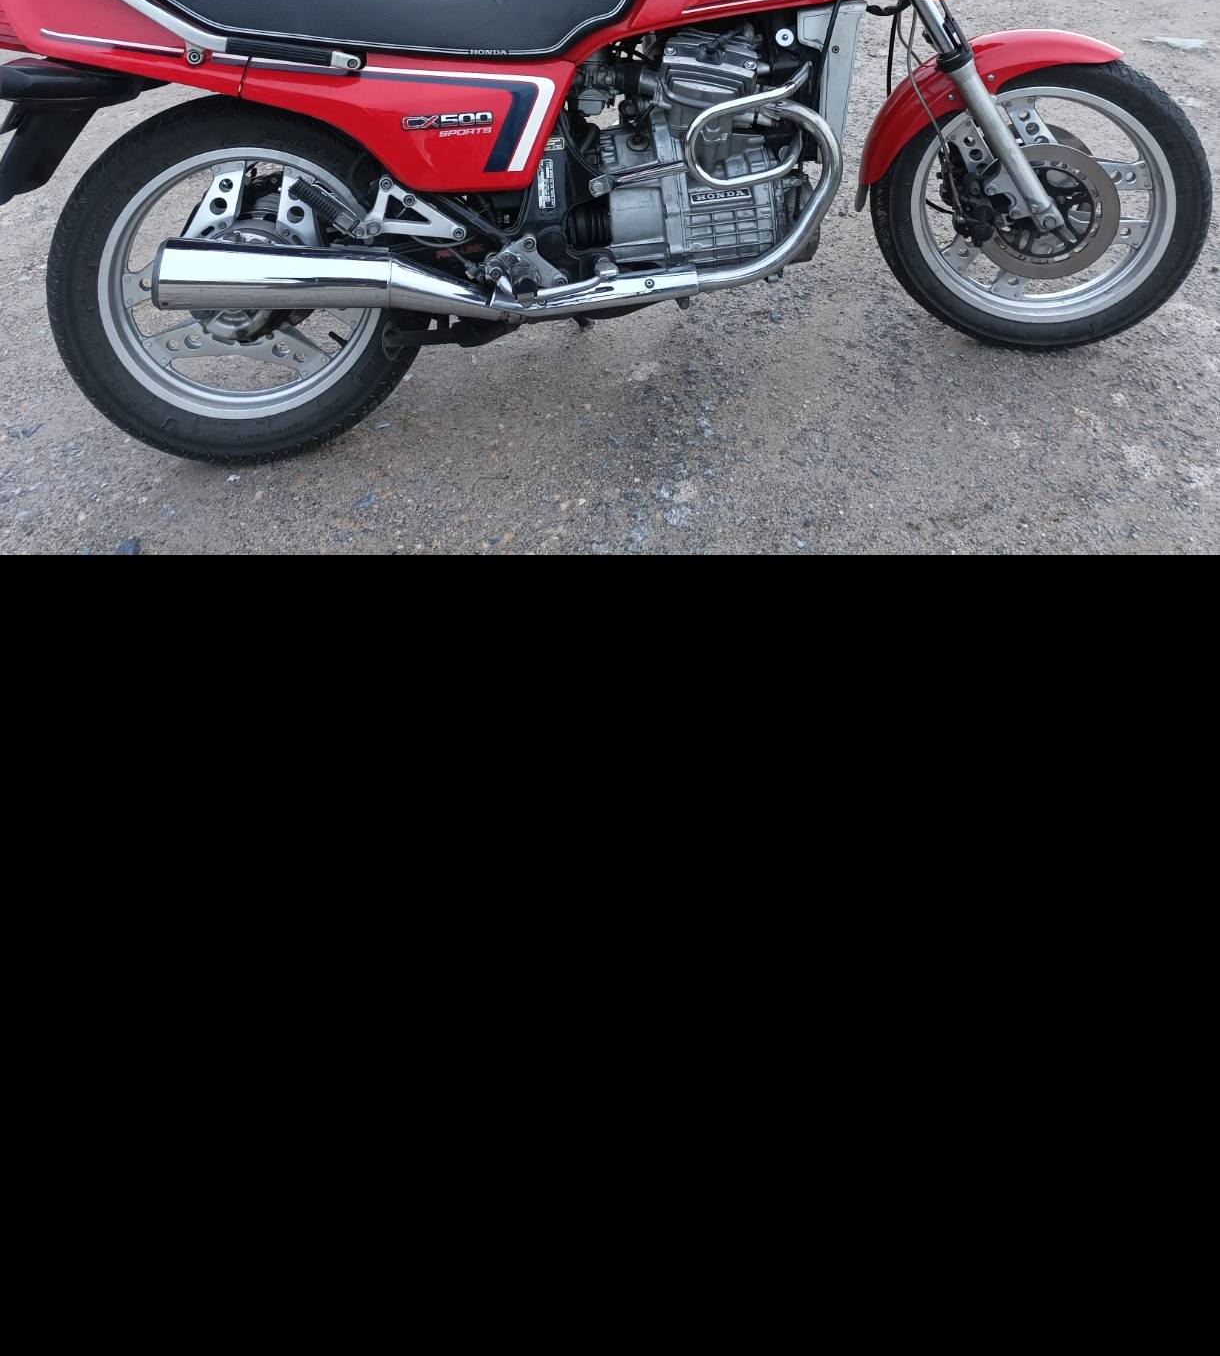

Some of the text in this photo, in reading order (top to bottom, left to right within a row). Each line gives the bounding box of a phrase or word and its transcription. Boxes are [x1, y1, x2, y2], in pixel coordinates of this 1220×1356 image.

[402, 111, 493, 130] CX500
[439, 127, 492, 137] SPORTS
[696, 190, 746, 201] HONDA
